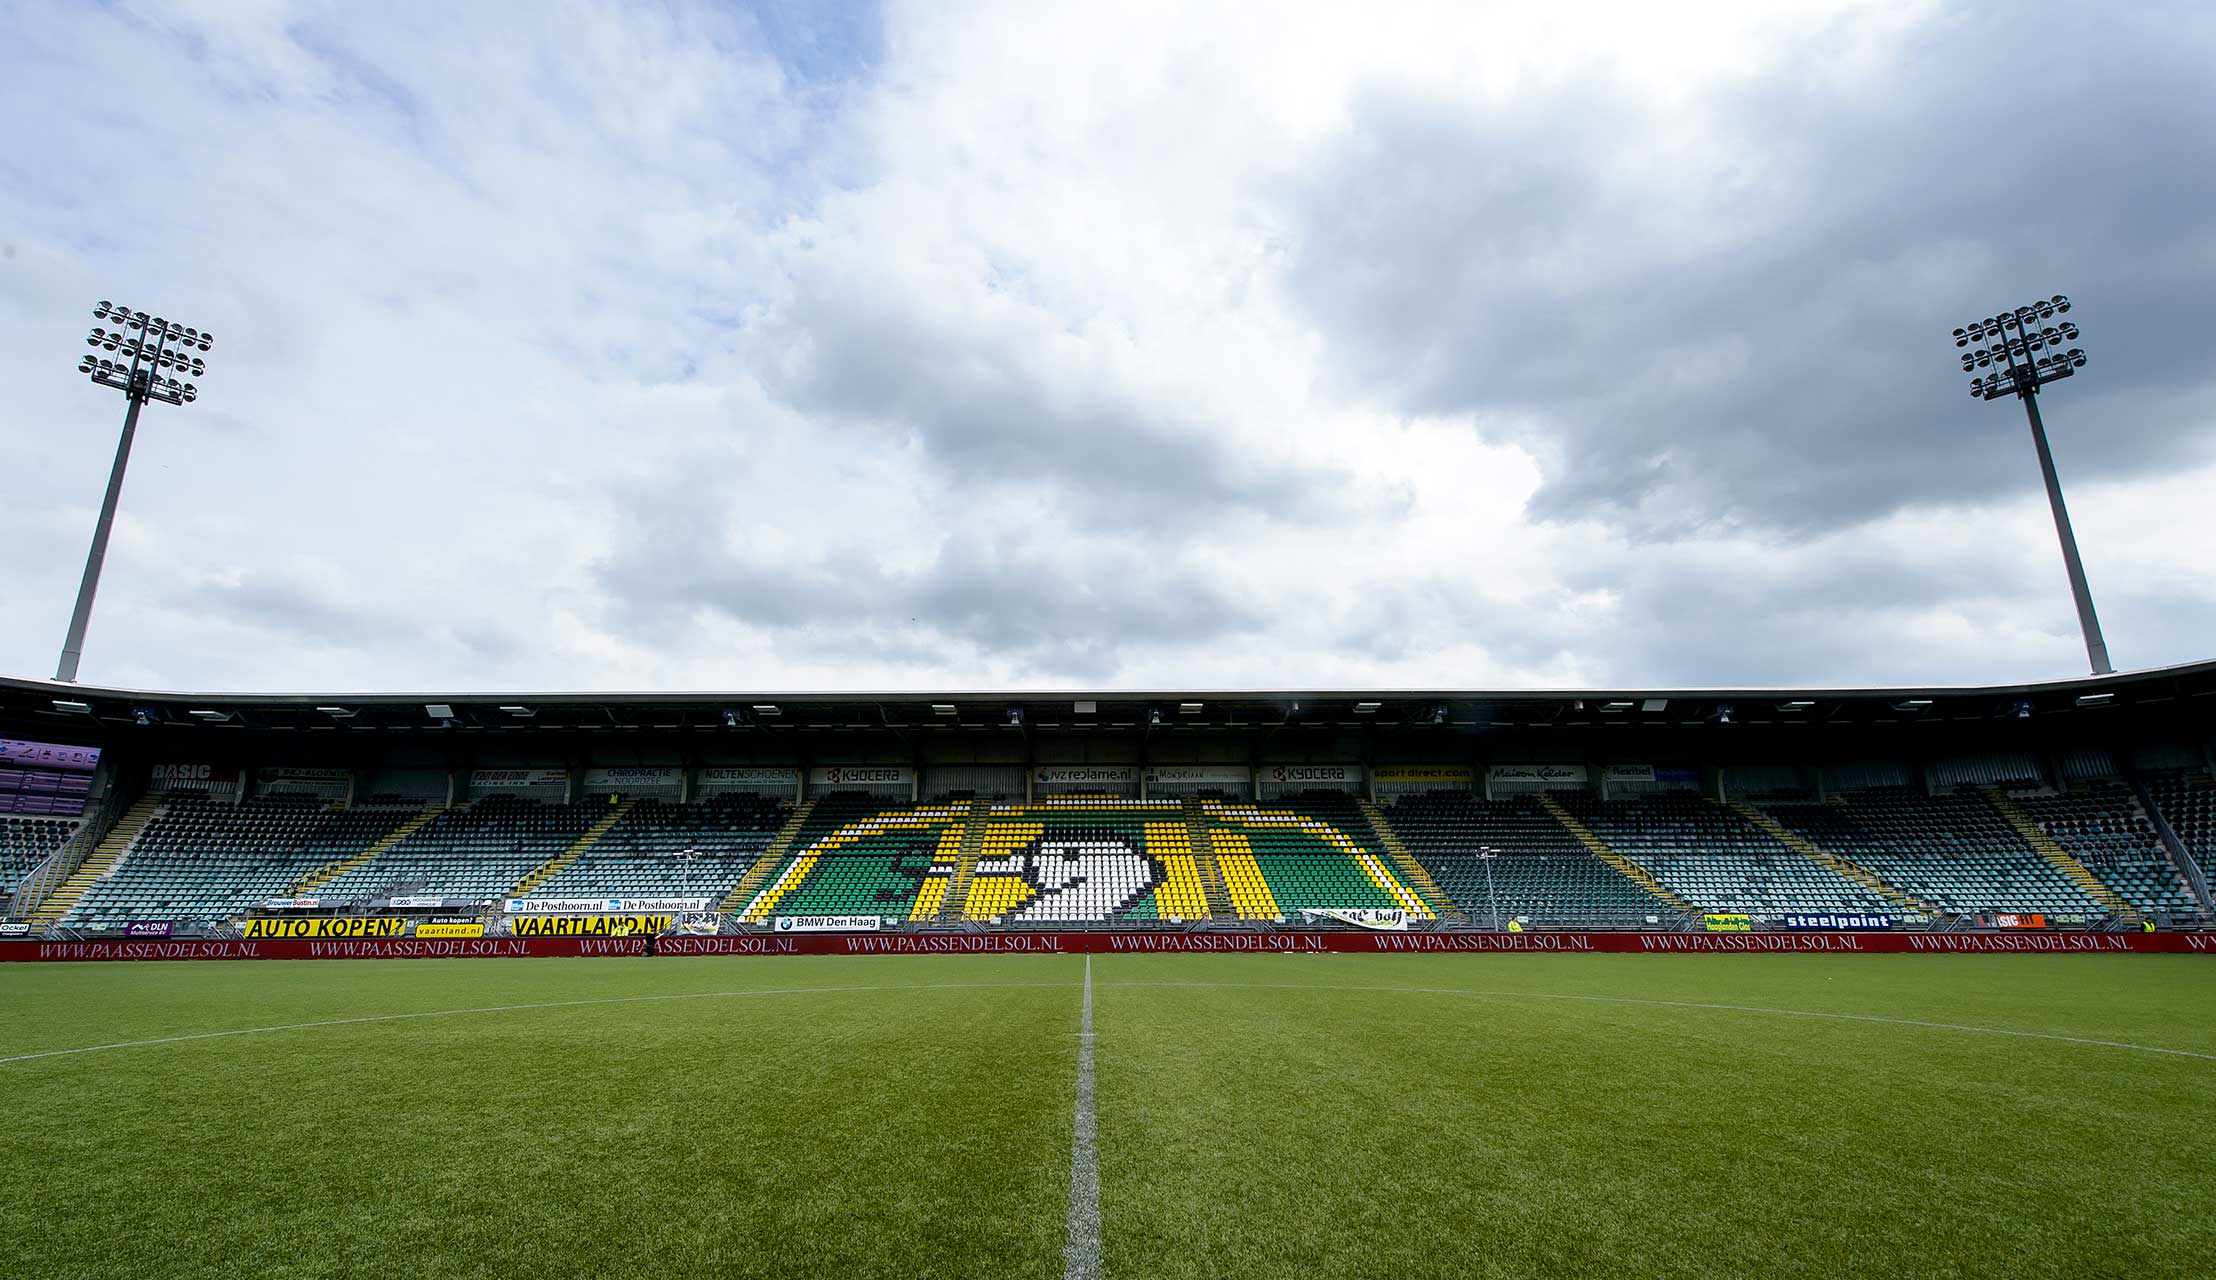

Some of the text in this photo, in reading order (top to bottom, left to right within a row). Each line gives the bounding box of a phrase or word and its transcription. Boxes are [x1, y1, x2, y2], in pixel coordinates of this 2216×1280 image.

[152, 764, 211, 780] BASIC
[607, 768, 671, 777] CHIROPRACTIE
[526, 900, 603, 911] De Posthoorn.nl
[623, 900, 699, 910] De Posthoorn.nl
[150, 922, 169, 931] DLN
[249, 918, 404, 937] AUTO KOPEN?
[449, 917, 473, 925] kopen?
[796, 916, 876, 928] BMW Den Haag
[1787, 914, 1889, 929] steelpoint
[419, 927, 480, 935] vaartland.nl
[310, 941, 531, 956] WWW.PAASSENDELSOL.NL
[846, 936, 1064, 952] WWW.PAASSENDELSOL.NL
[1110, 935, 1328, 951] WWW.PAASSENDELSOL.NL
[1374, 935, 1594, 950] WWW.PAASSENDELSOL.NL
[1639, 935, 1864, 951] WWW.PAASSENDELSOL.NL
[1909, 935, 2134, 950] WWW.PAASSENDELSOL.NL
[39, 943, 261, 958] WWW.PAASSENDELSOL.NL
